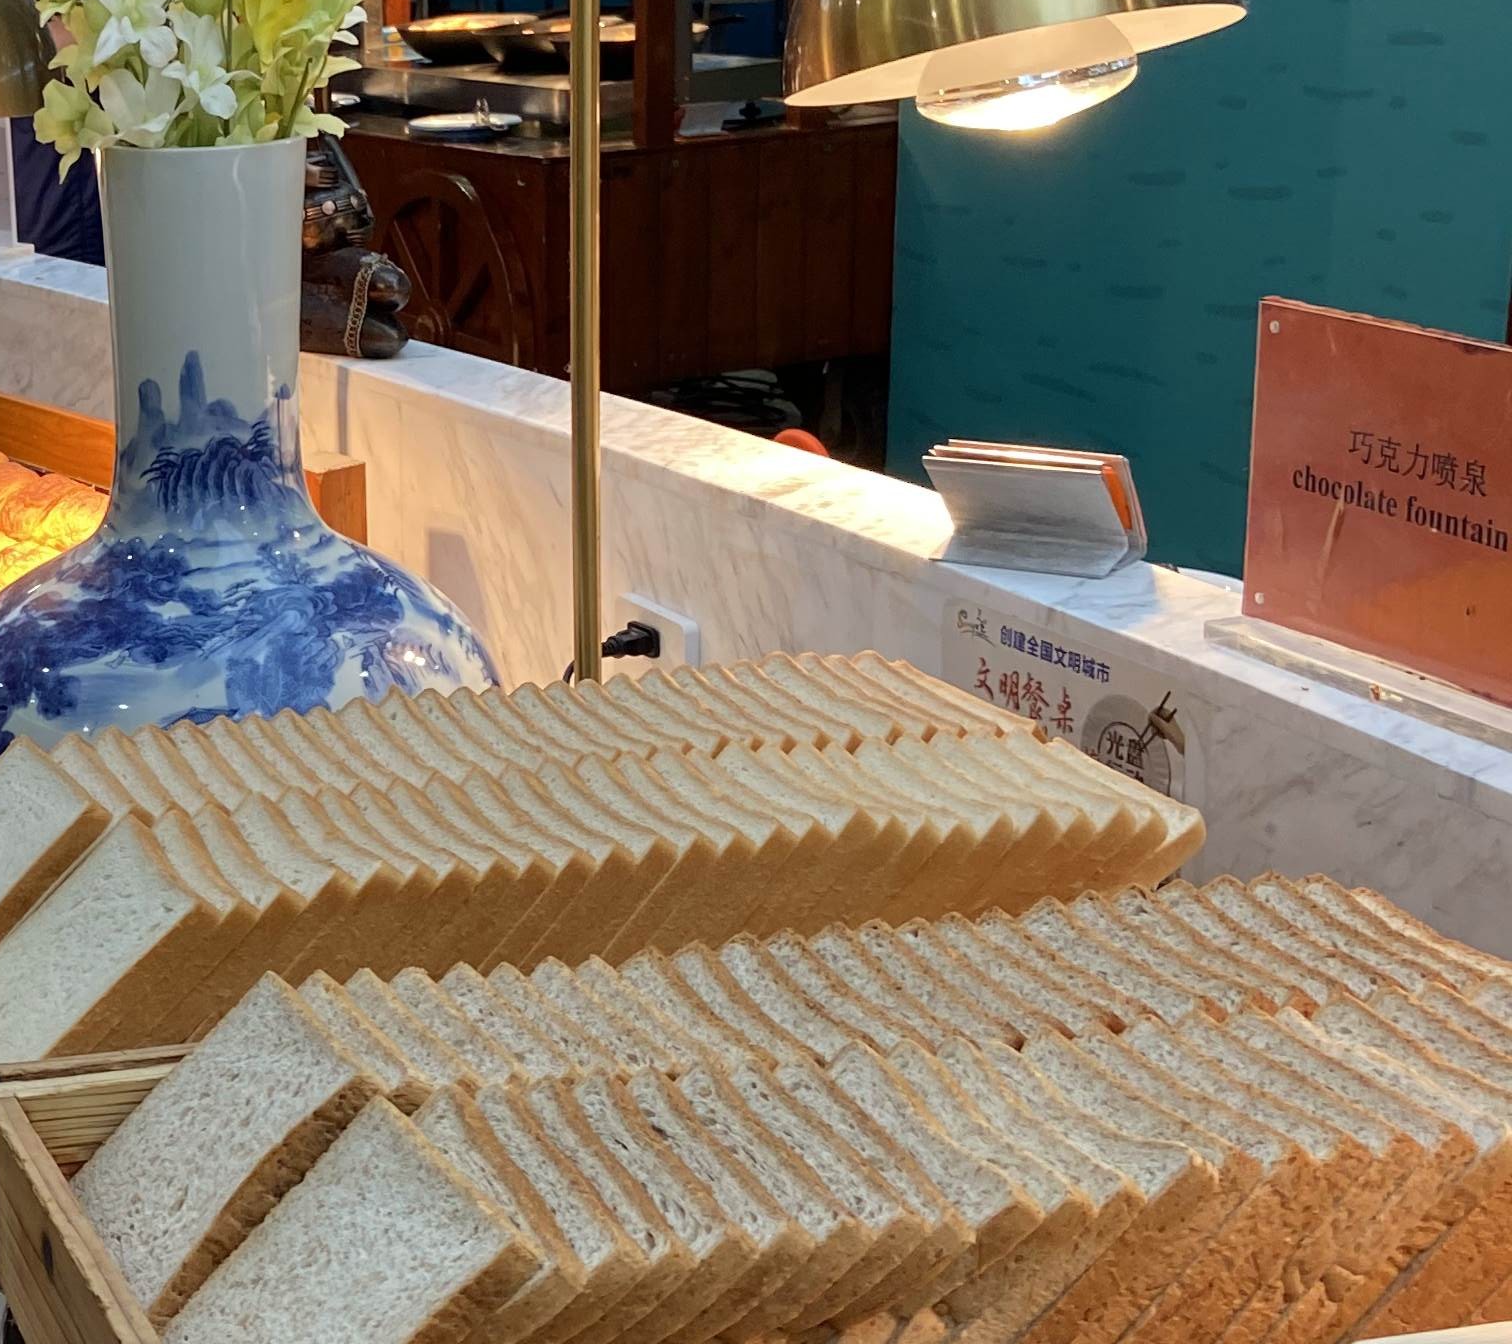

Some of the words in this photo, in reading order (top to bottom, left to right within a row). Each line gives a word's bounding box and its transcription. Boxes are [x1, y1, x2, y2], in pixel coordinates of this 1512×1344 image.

[1348, 430, 1487, 497] 巧克力喷泉
[1292, 464, 1398, 517] chocolate
[1405, 495, 1509, 552] fountain
[999, 624, 1110, 684] 创建全国文明城市
[974, 657, 1074, 734] 文明餐桌
